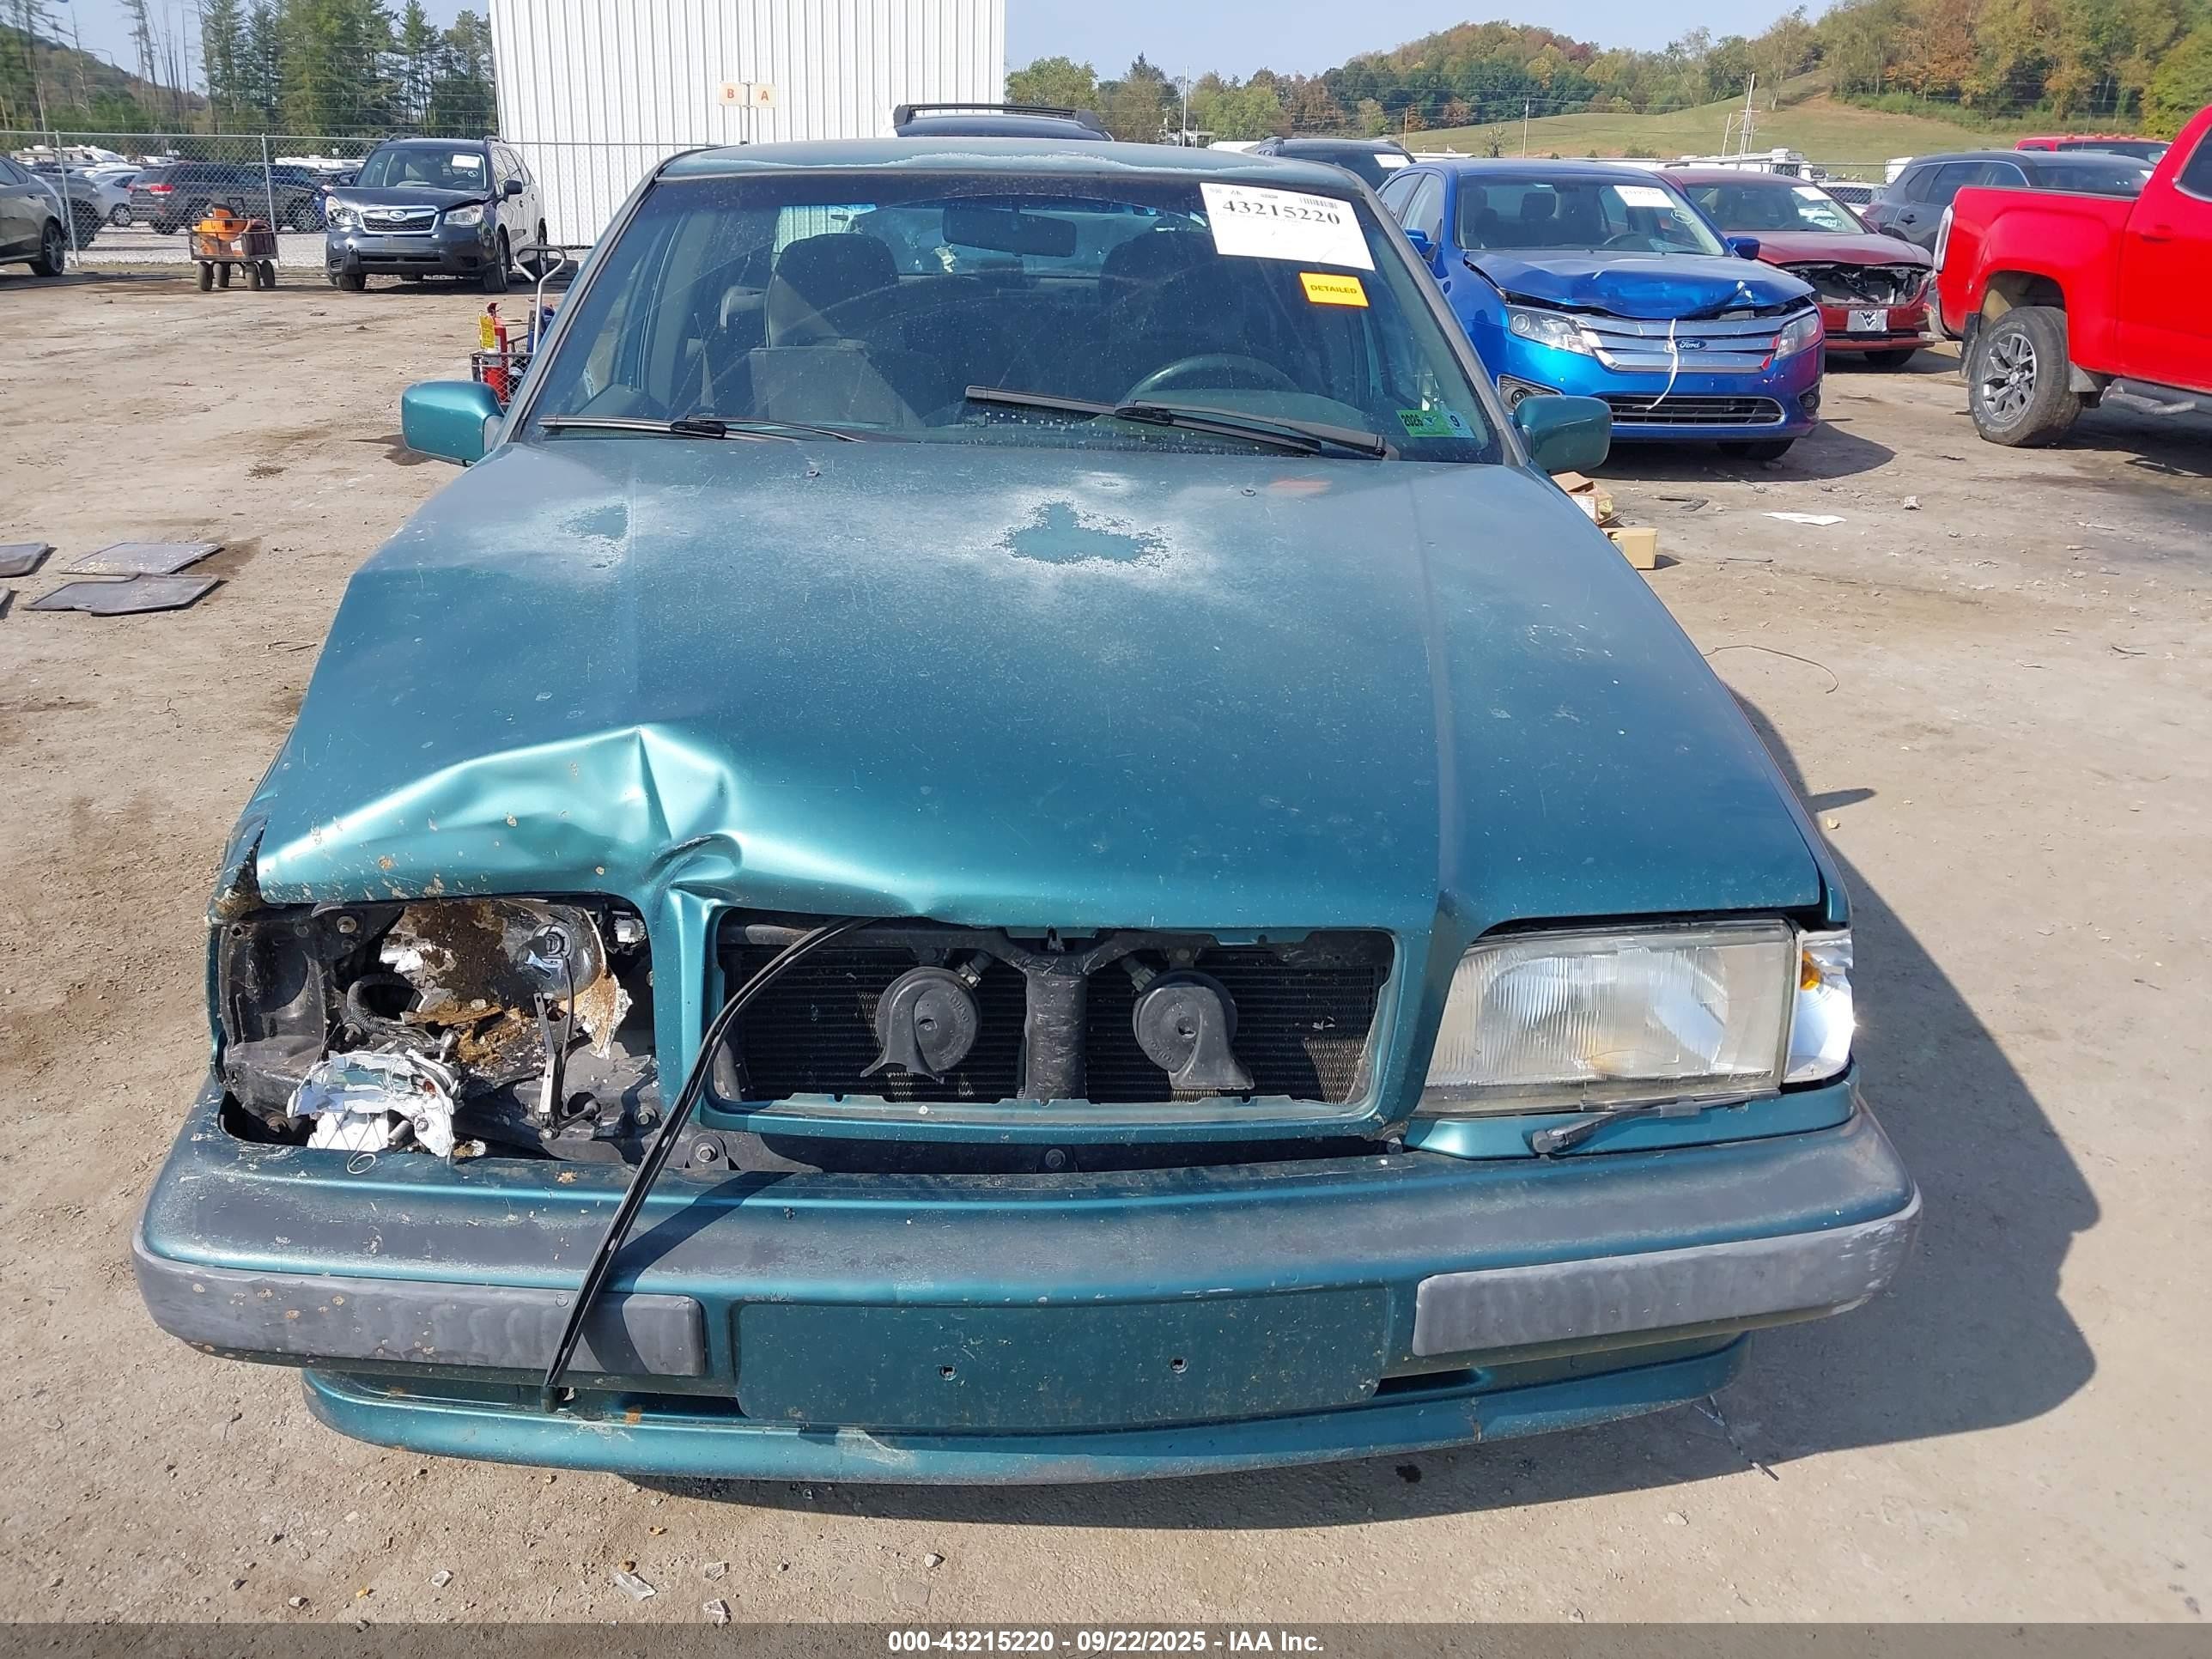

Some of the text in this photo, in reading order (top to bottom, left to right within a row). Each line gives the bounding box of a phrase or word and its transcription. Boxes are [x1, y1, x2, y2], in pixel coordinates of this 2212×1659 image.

[727, 88, 735, 99] B
[761, 90, 769, 100] A
[1222, 199, 1341, 226] 43215220
[1310, 284, 1358, 295] DETAILED
[1680, 339, 1701, 349] Ford
[1449, 415, 1461, 428] 9
